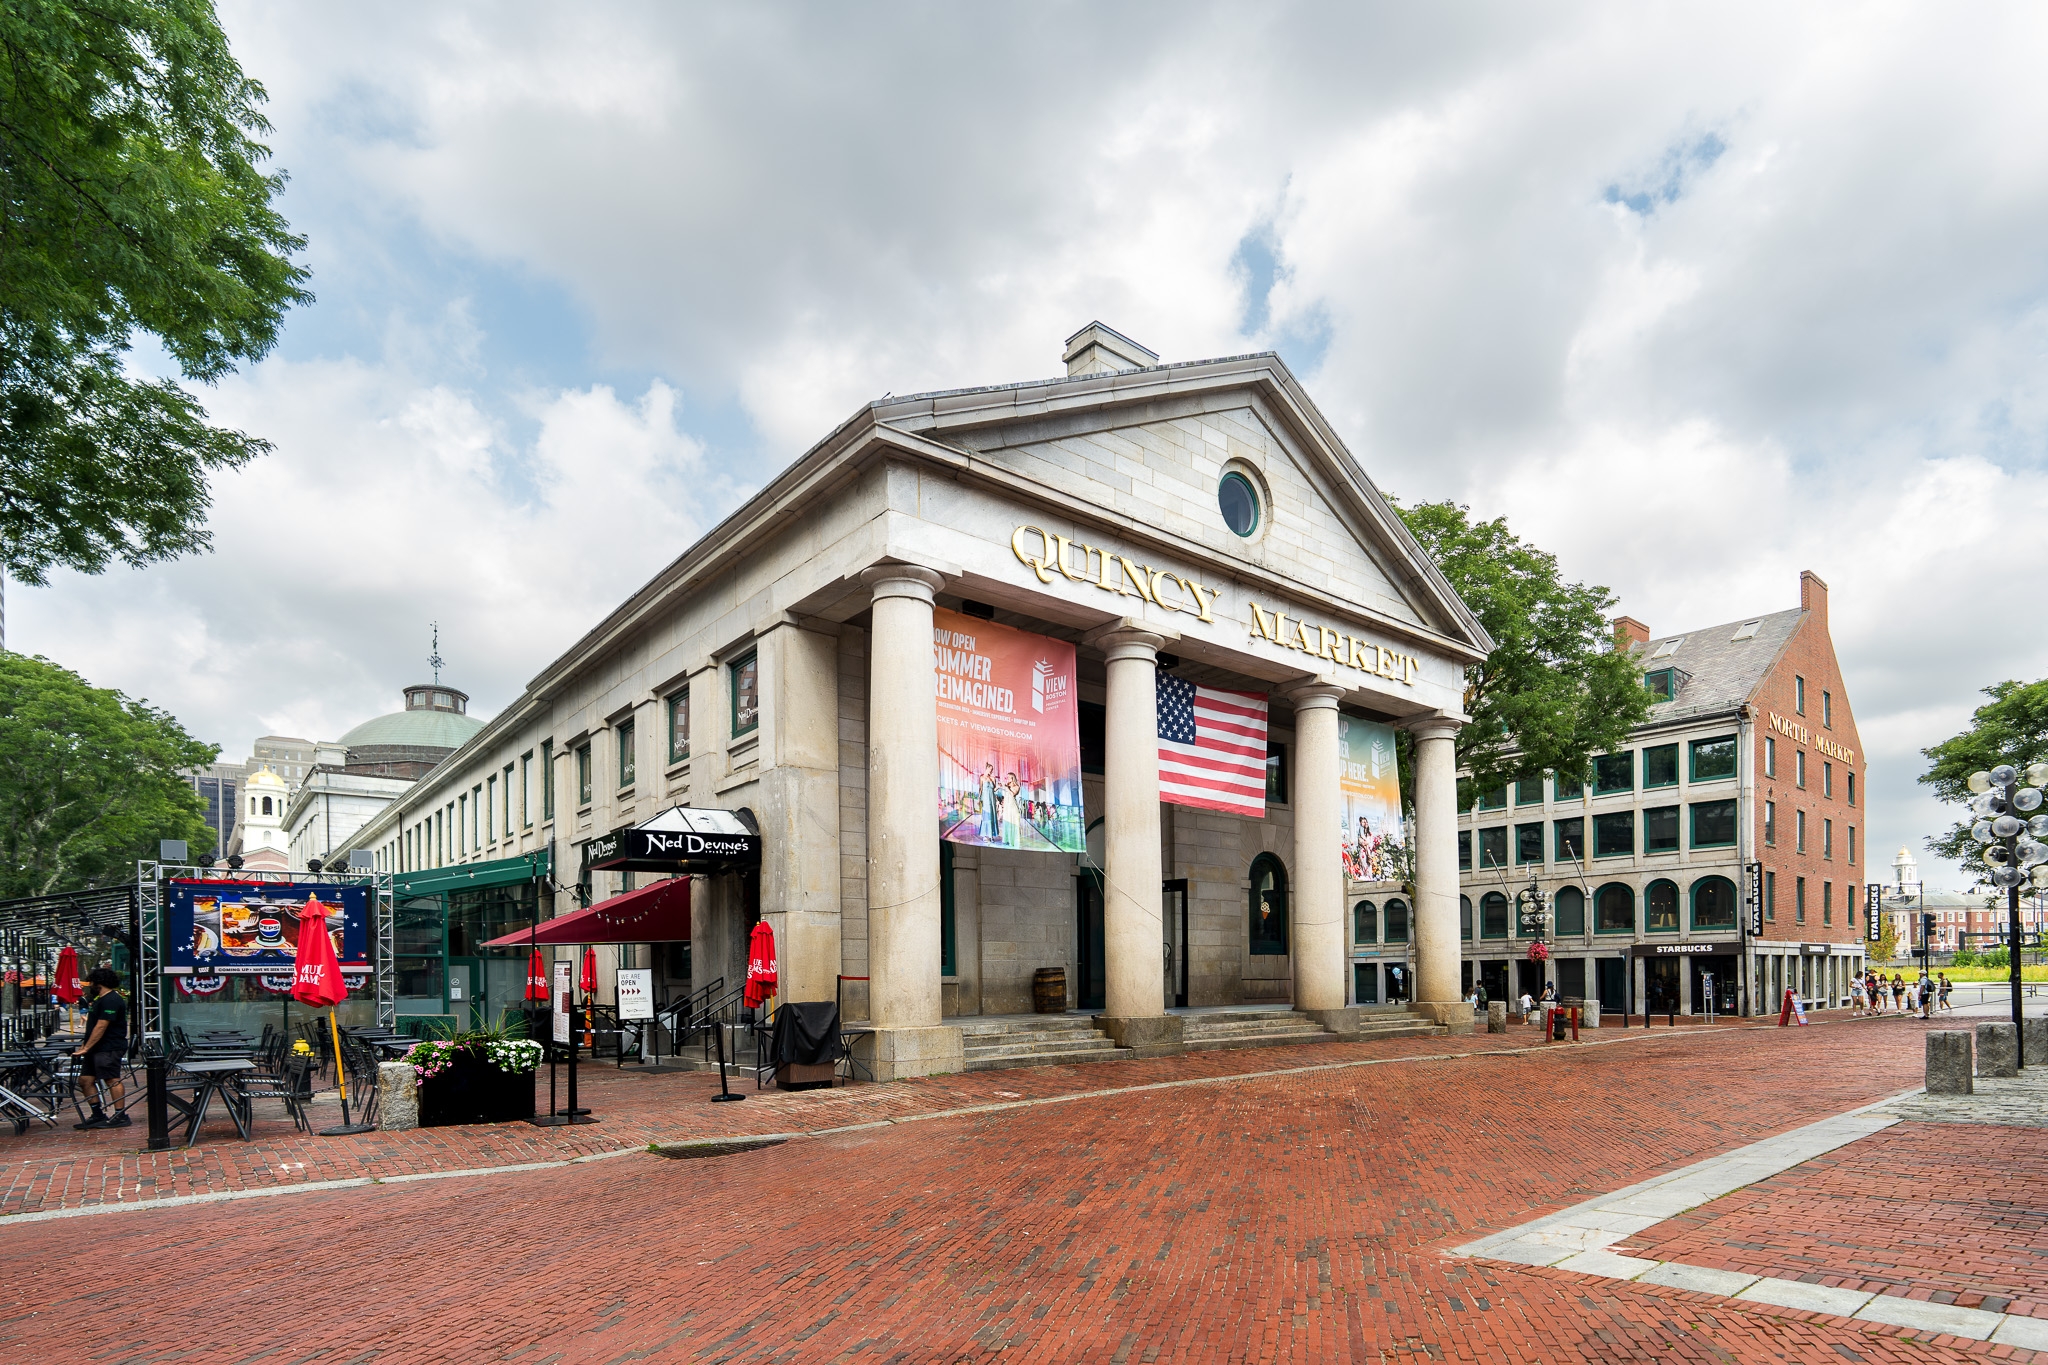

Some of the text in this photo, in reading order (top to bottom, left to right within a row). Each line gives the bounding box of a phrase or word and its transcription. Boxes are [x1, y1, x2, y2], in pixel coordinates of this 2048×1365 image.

[1011, 525, 1420, 687] QUINCY MARKET
[952, 632, 976, 652] OPEN
[1045, 675, 1067, 693] VIEW
[1045, 690, 1067, 701] BOSTON
[960, 720, 969, 728] AT
[970, 722, 1033, 740] VIEWBOSTON.COM
[1768, 711, 1855, 765] NORTH MARKET
[1348, 761, 1369, 782] HERE.
[645, 833, 683, 855] Ned
[1870, 885, 1879, 941] STARBUCKS
[1656, 944, 1713, 953] STARBUCKS
